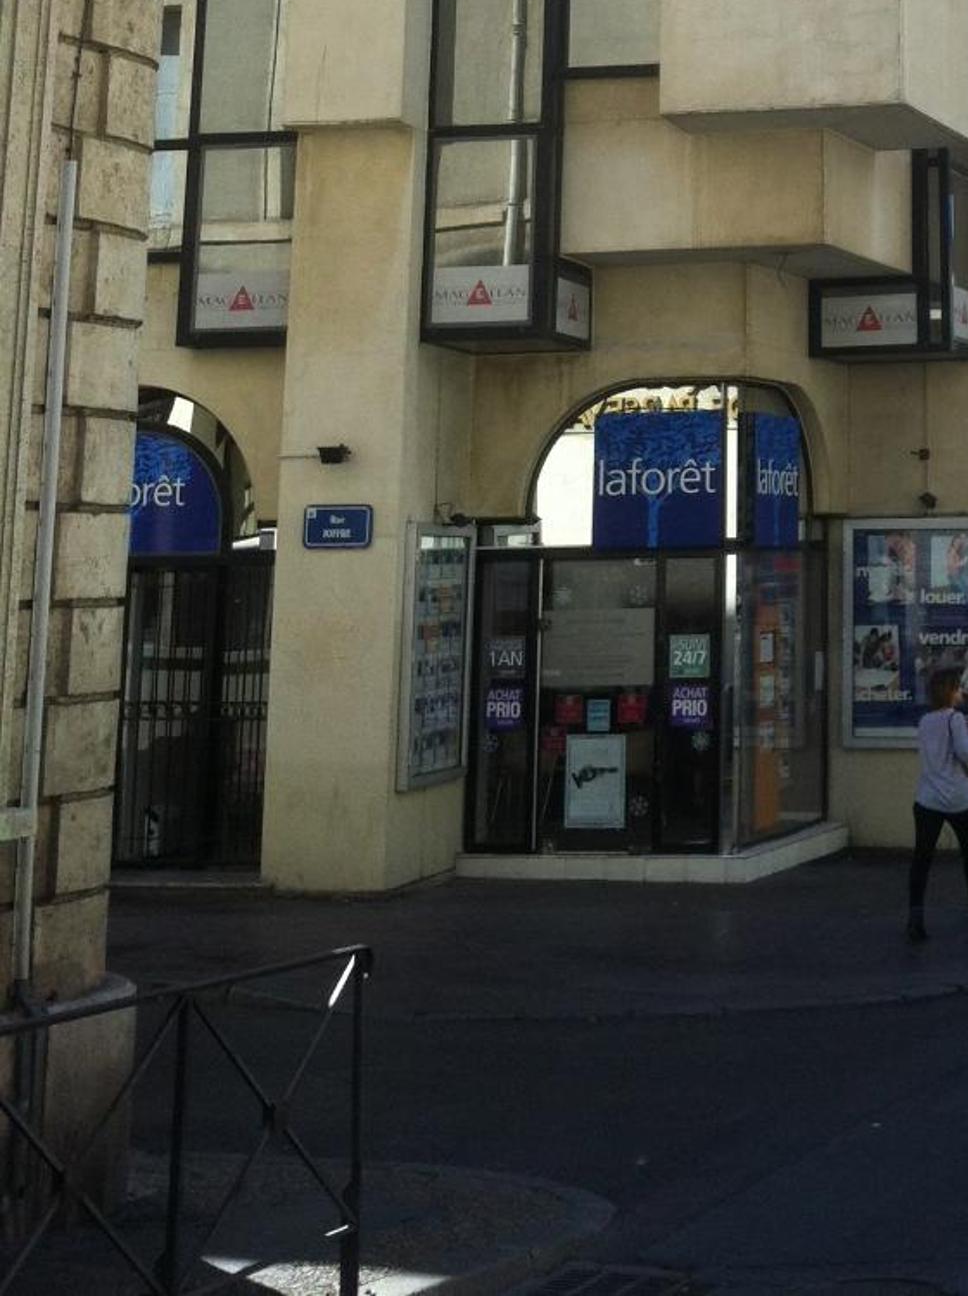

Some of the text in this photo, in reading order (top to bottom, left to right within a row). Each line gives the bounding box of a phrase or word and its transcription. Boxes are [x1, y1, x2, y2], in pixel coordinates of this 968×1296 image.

[599, 457, 716, 497] laforêt
[756, 458, 799, 497] laforêt
[920, 588, 965, 604] louer.
[498, 650, 522, 666] AN
[673, 650, 705, 666] 24/7
[487, 689, 521, 701] ACHAT
[672, 687, 706, 698] ACHAT
[486, 701, 520, 718] PRIO
[672, 699, 707, 716] PRIO
